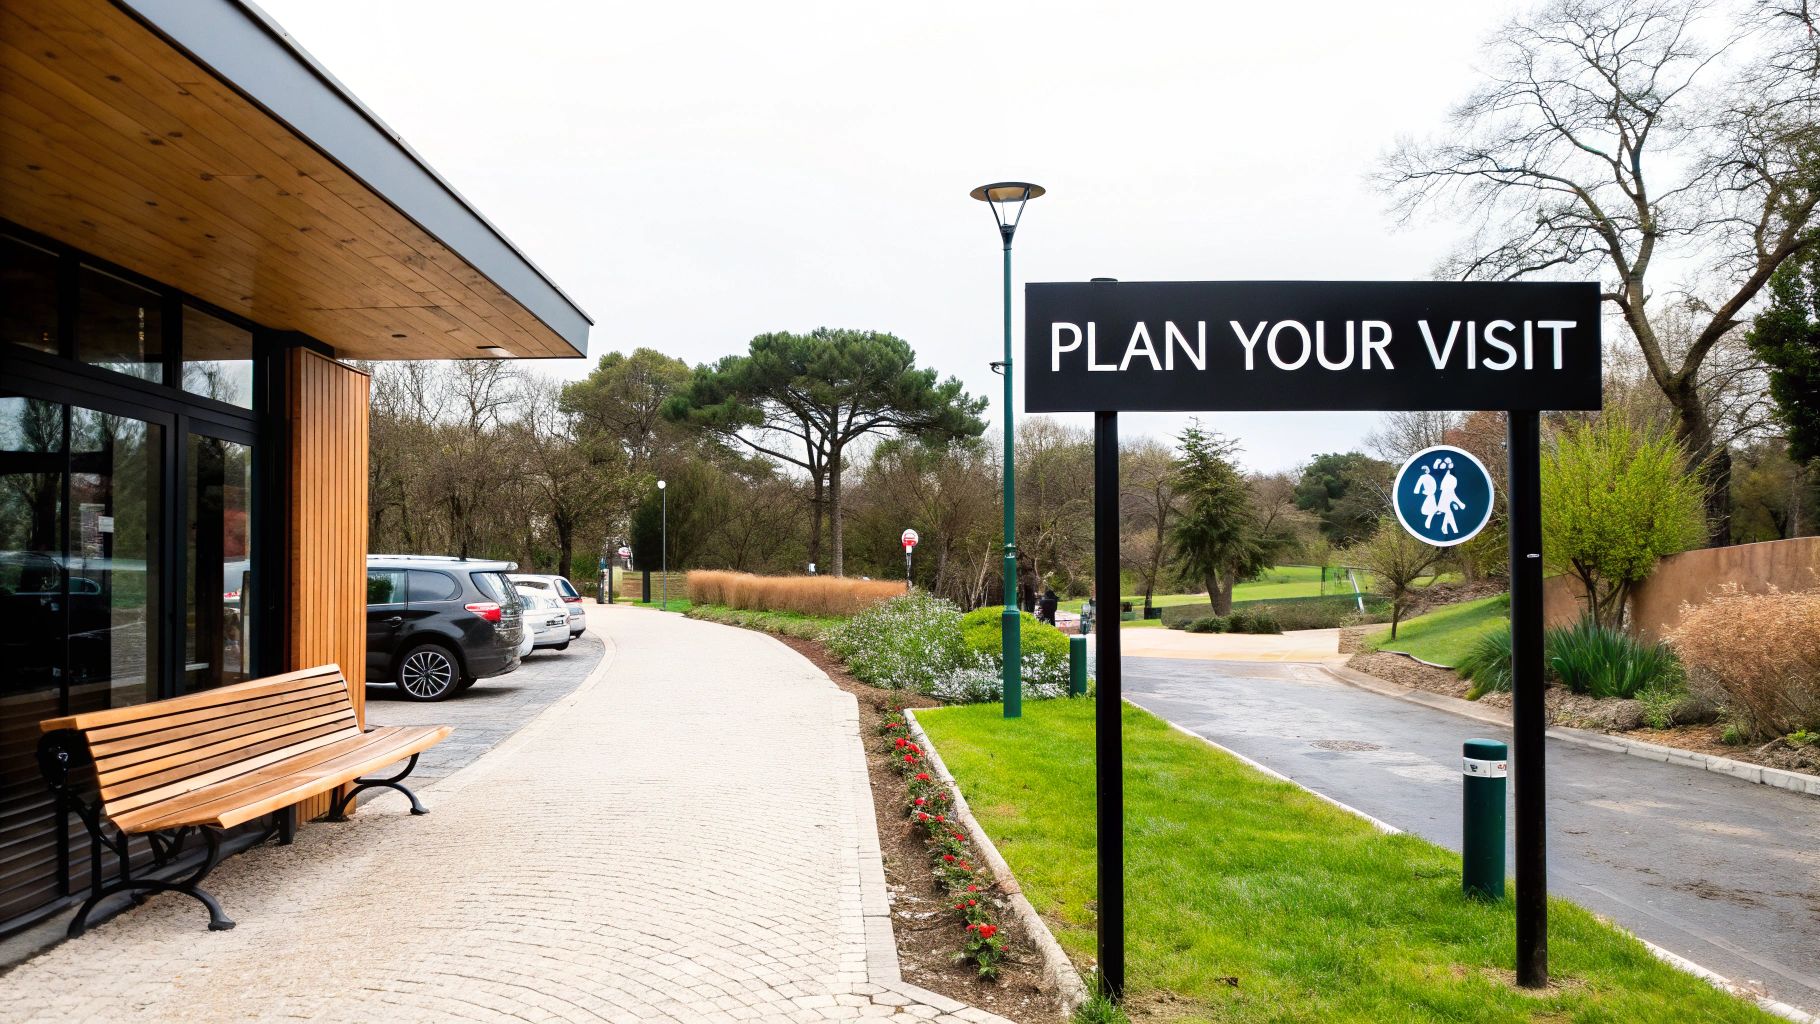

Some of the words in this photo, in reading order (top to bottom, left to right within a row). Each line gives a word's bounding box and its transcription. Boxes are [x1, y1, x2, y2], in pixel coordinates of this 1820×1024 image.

[1051, 321, 1206, 371] PLAN
[1229, 319, 1394, 371] YOUR
[1417, 319, 1577, 371] VISIT
